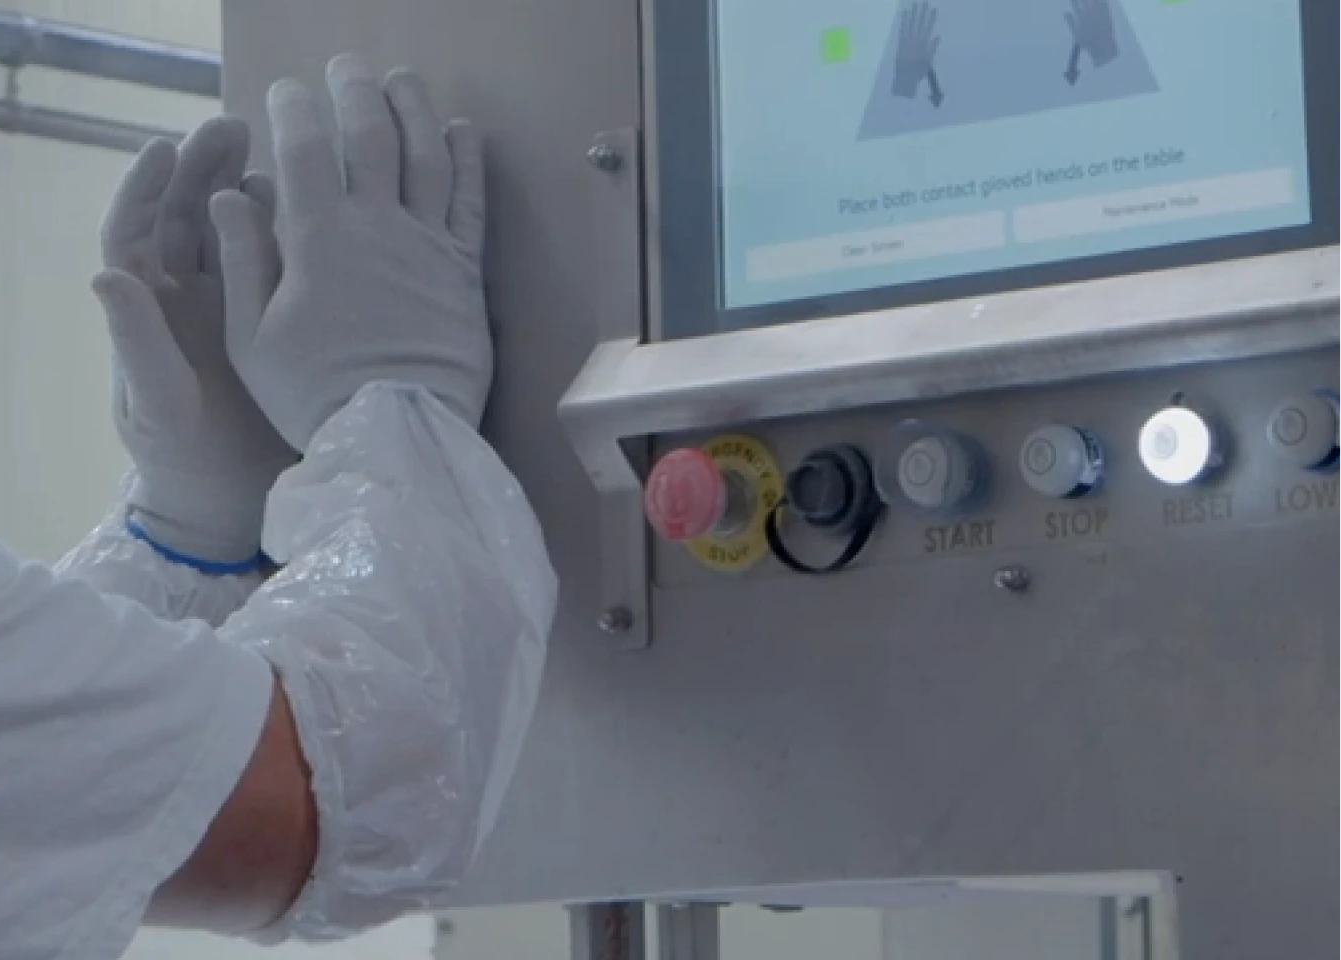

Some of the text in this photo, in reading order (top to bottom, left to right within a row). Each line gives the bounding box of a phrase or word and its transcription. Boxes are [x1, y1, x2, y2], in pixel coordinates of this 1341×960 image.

[839, 147, 1185, 215] Place both contact gloved hands on the table
[1045, 505, 1110, 541] STOP
[1162, 493, 1236, 528] RESET
[924, 518, 996, 554] START
